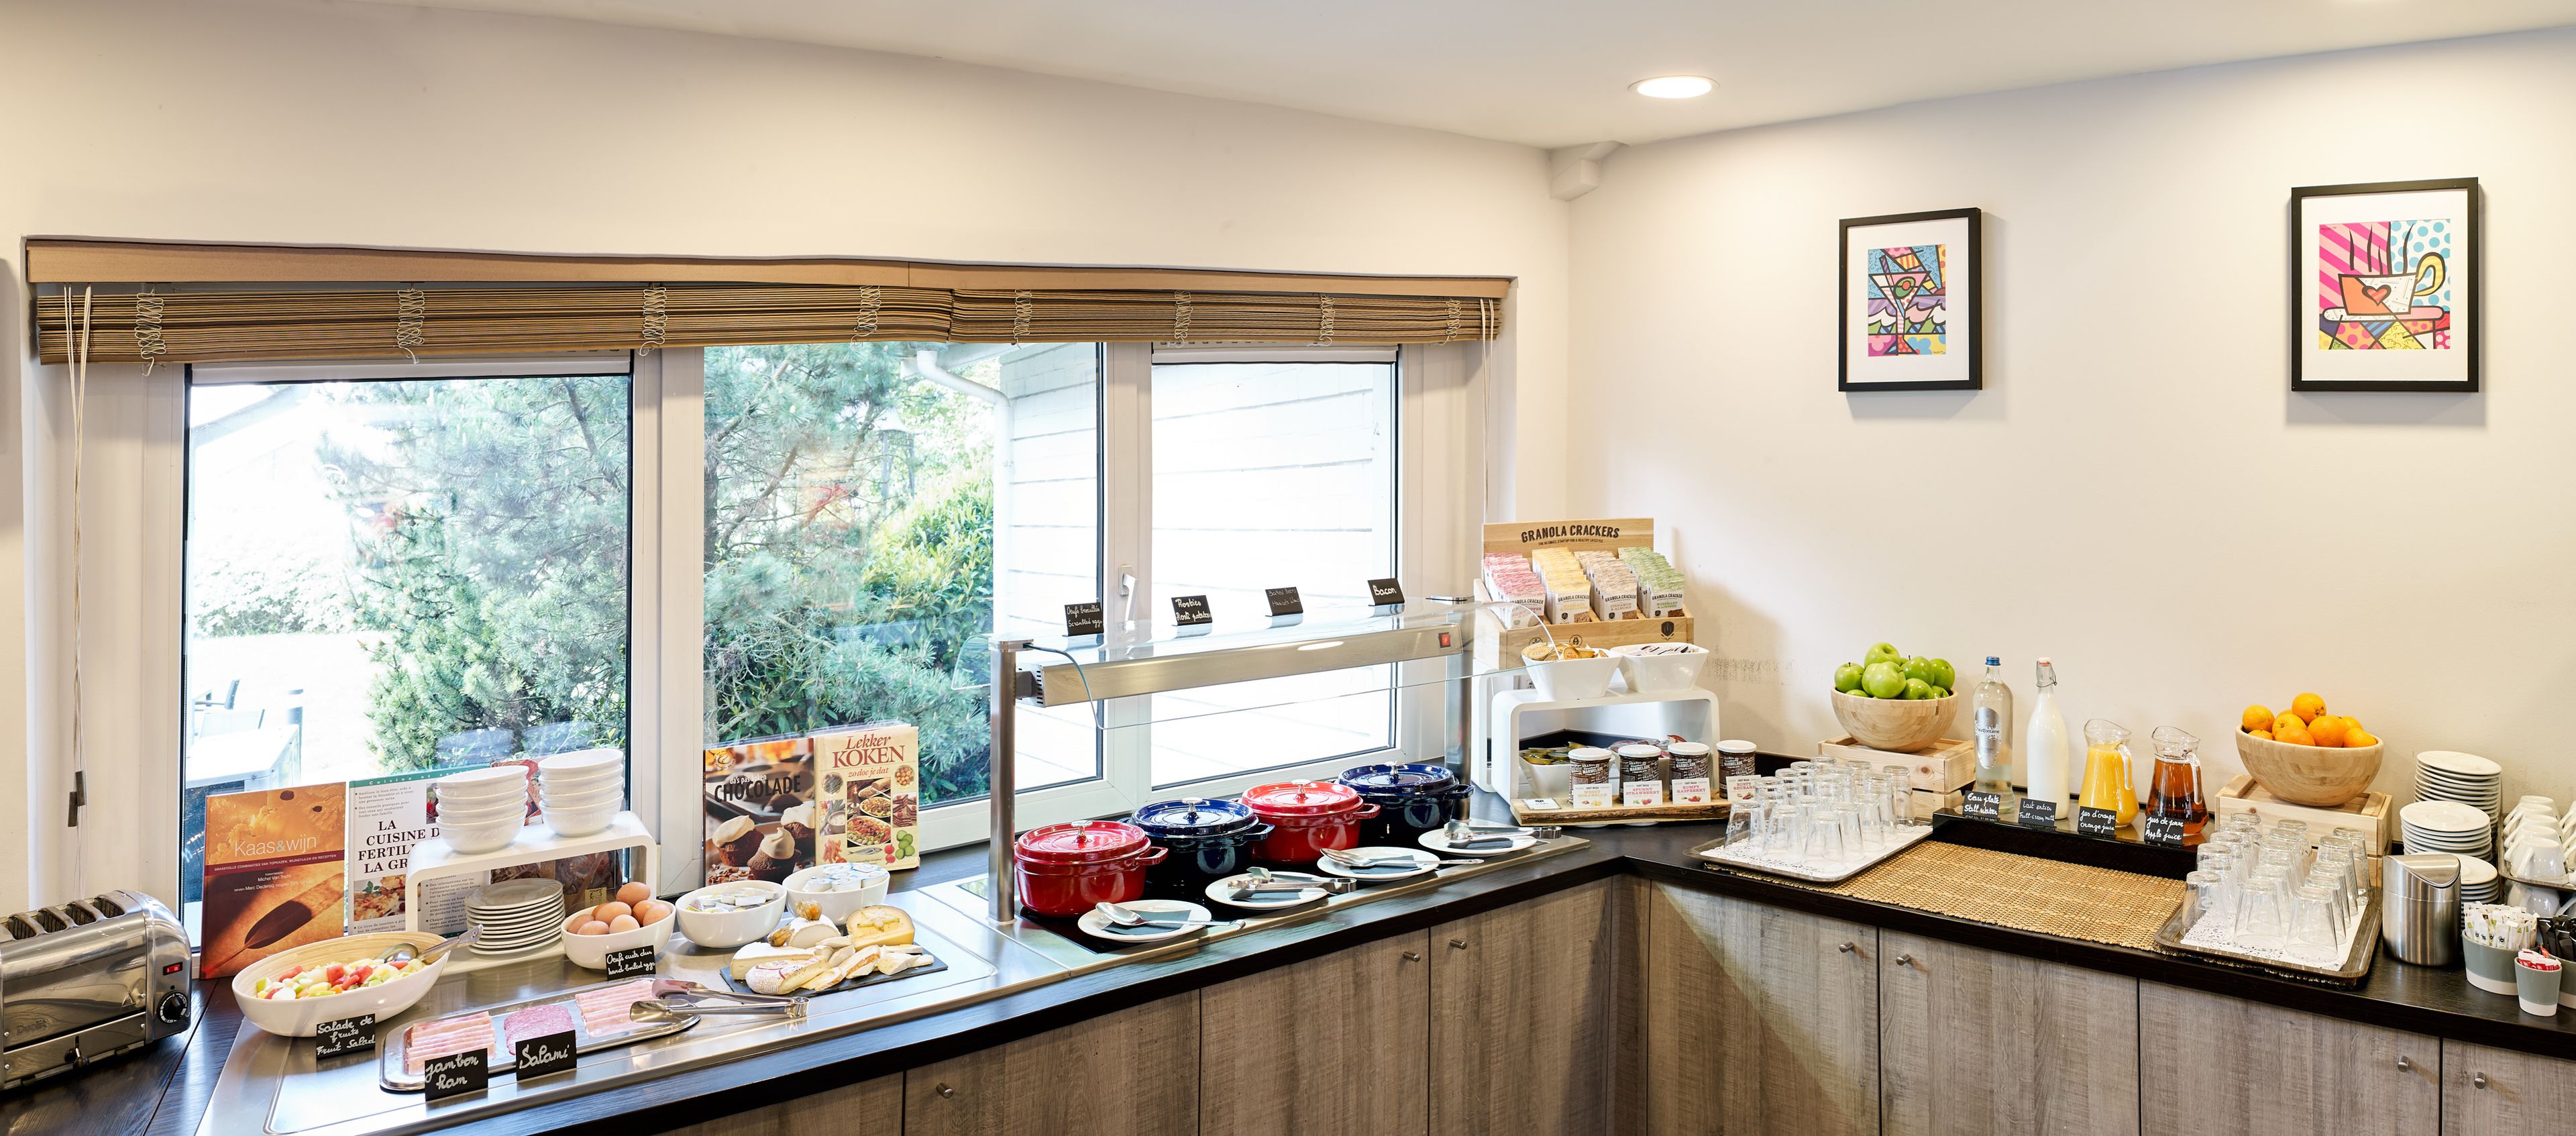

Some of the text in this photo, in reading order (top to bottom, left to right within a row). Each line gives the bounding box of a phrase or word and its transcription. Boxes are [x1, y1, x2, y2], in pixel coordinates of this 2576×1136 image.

[1521, 525, 1620, 543] GRANOLA CRACKERS
[1372, 584, 1397, 596] Bacon
[845, 733, 891, 750] Lekker
[832, 745, 906, 768] KOKEN
[857, 768, 869, 776] doe
[869, 768, 876, 778] je
[876, 766, 890, 774] dat
[369, 777, 412, 785] Cuisine
[729, 776, 740, 784] da's
[741, 776, 750, 784] pas
[714, 775, 801, 803] CHOCOLADE
[1968, 792, 2001, 807] Eau plate
[2023, 801, 2035, 809] Lait
[1964, 804, 1998, 815] Still water
[2092, 810, 2115, 824] d'orange
[378, 819, 396, 831] LA
[2080, 822, 2101, 832] orange
[2159, 817, 2168, 825] de
[366, 827, 440, 846] CUISINE D
[2145, 829, 2182, 841] Apple juice
[235, 834, 317, 857] Kaas&wijn
[358, 843, 415, 861] FERTIL
[364, 858, 407, 874] LA GR
[606, 952, 625, 966] Oeufs
[625, 950, 639, 960] cuits
[608, 961, 655, 976] hard boiled eggs
[317, 1015, 374, 1034] Salade de
[329, 1028, 359, 1043] fruits
[316, 1034, 376, 1055] Fruit Salad
[519, 1043, 570, 1070] Salami
[436, 1074, 468, 1090] ham
